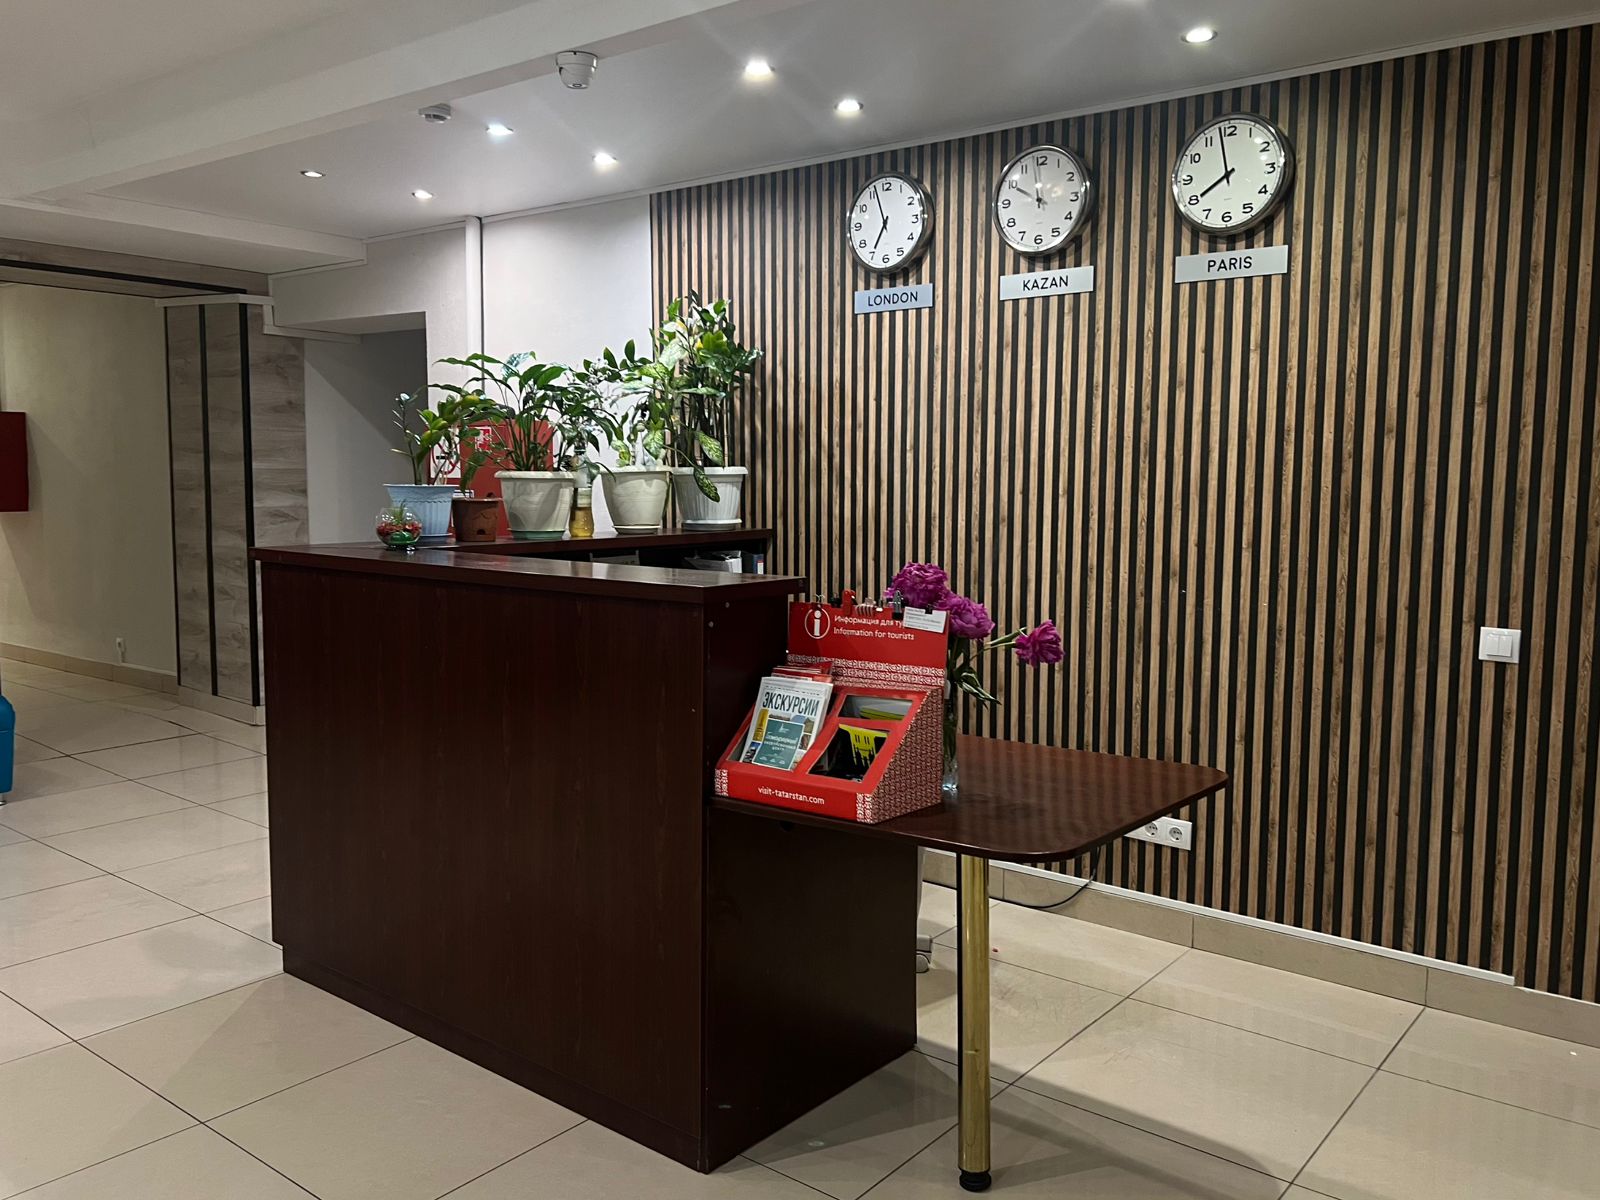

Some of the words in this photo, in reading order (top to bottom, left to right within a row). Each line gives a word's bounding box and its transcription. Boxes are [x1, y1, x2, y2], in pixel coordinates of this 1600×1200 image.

[1223, 125, 1237, 137] 12
[1205, 136, 1213, 148] 11
[1260, 141, 1270, 153] 2
[1036, 156, 1048, 166] 12
[1190, 153, 1201, 164] 10
[1021, 165, 1028, 174] 11
[1265, 162, 1276, 174] 3
[1066, 172, 1075, 182] 2
[1182, 175, 1193, 186] 9
[882, 182, 892, 192] 12
[1008, 179, 1018, 189] 10
[1258, 184, 1268, 195] 4
[870, 191, 876, 200] 11
[1070, 192, 1079, 202] 3
[1188, 195, 1200, 206] 8
[907, 197, 915, 206] 2
[1002, 199, 1011, 209] 9
[859, 204, 867, 213] 10
[1242, 203, 1253, 214] 5
[912, 214, 919, 224] 3
[1064, 211, 1073, 221] 4
[1202, 208, 1212, 220] 7
[1222, 212, 1233, 223] 6
[855, 223, 862, 231] 9
[1007, 218, 1016, 228] 8
[907, 232, 914, 241] 4
[1018, 231, 1026, 241] 7
[1052, 227, 1061, 238] 5
[859, 240, 867, 248] 8
[1034, 235, 1043, 245] 6
[869, 251, 876, 260] 7
[897, 248, 904, 257] 5
[882, 254, 890, 264] 6
[1207, 256, 1253, 273] PARIS
[1023, 275, 1069, 291] KAZAN
[868, 291, 918, 307] LONDON
[834, 615, 879, 626] Информация
[880, 619, 894, 627] для
[833, 627, 873, 637] Information
[874, 630, 886, 638] for
[887, 631, 915, 640] tourists
[762, 691, 820, 717] ЭКСКУРСИИ
[757, 785, 825, 805] visit-tatarstan.com
